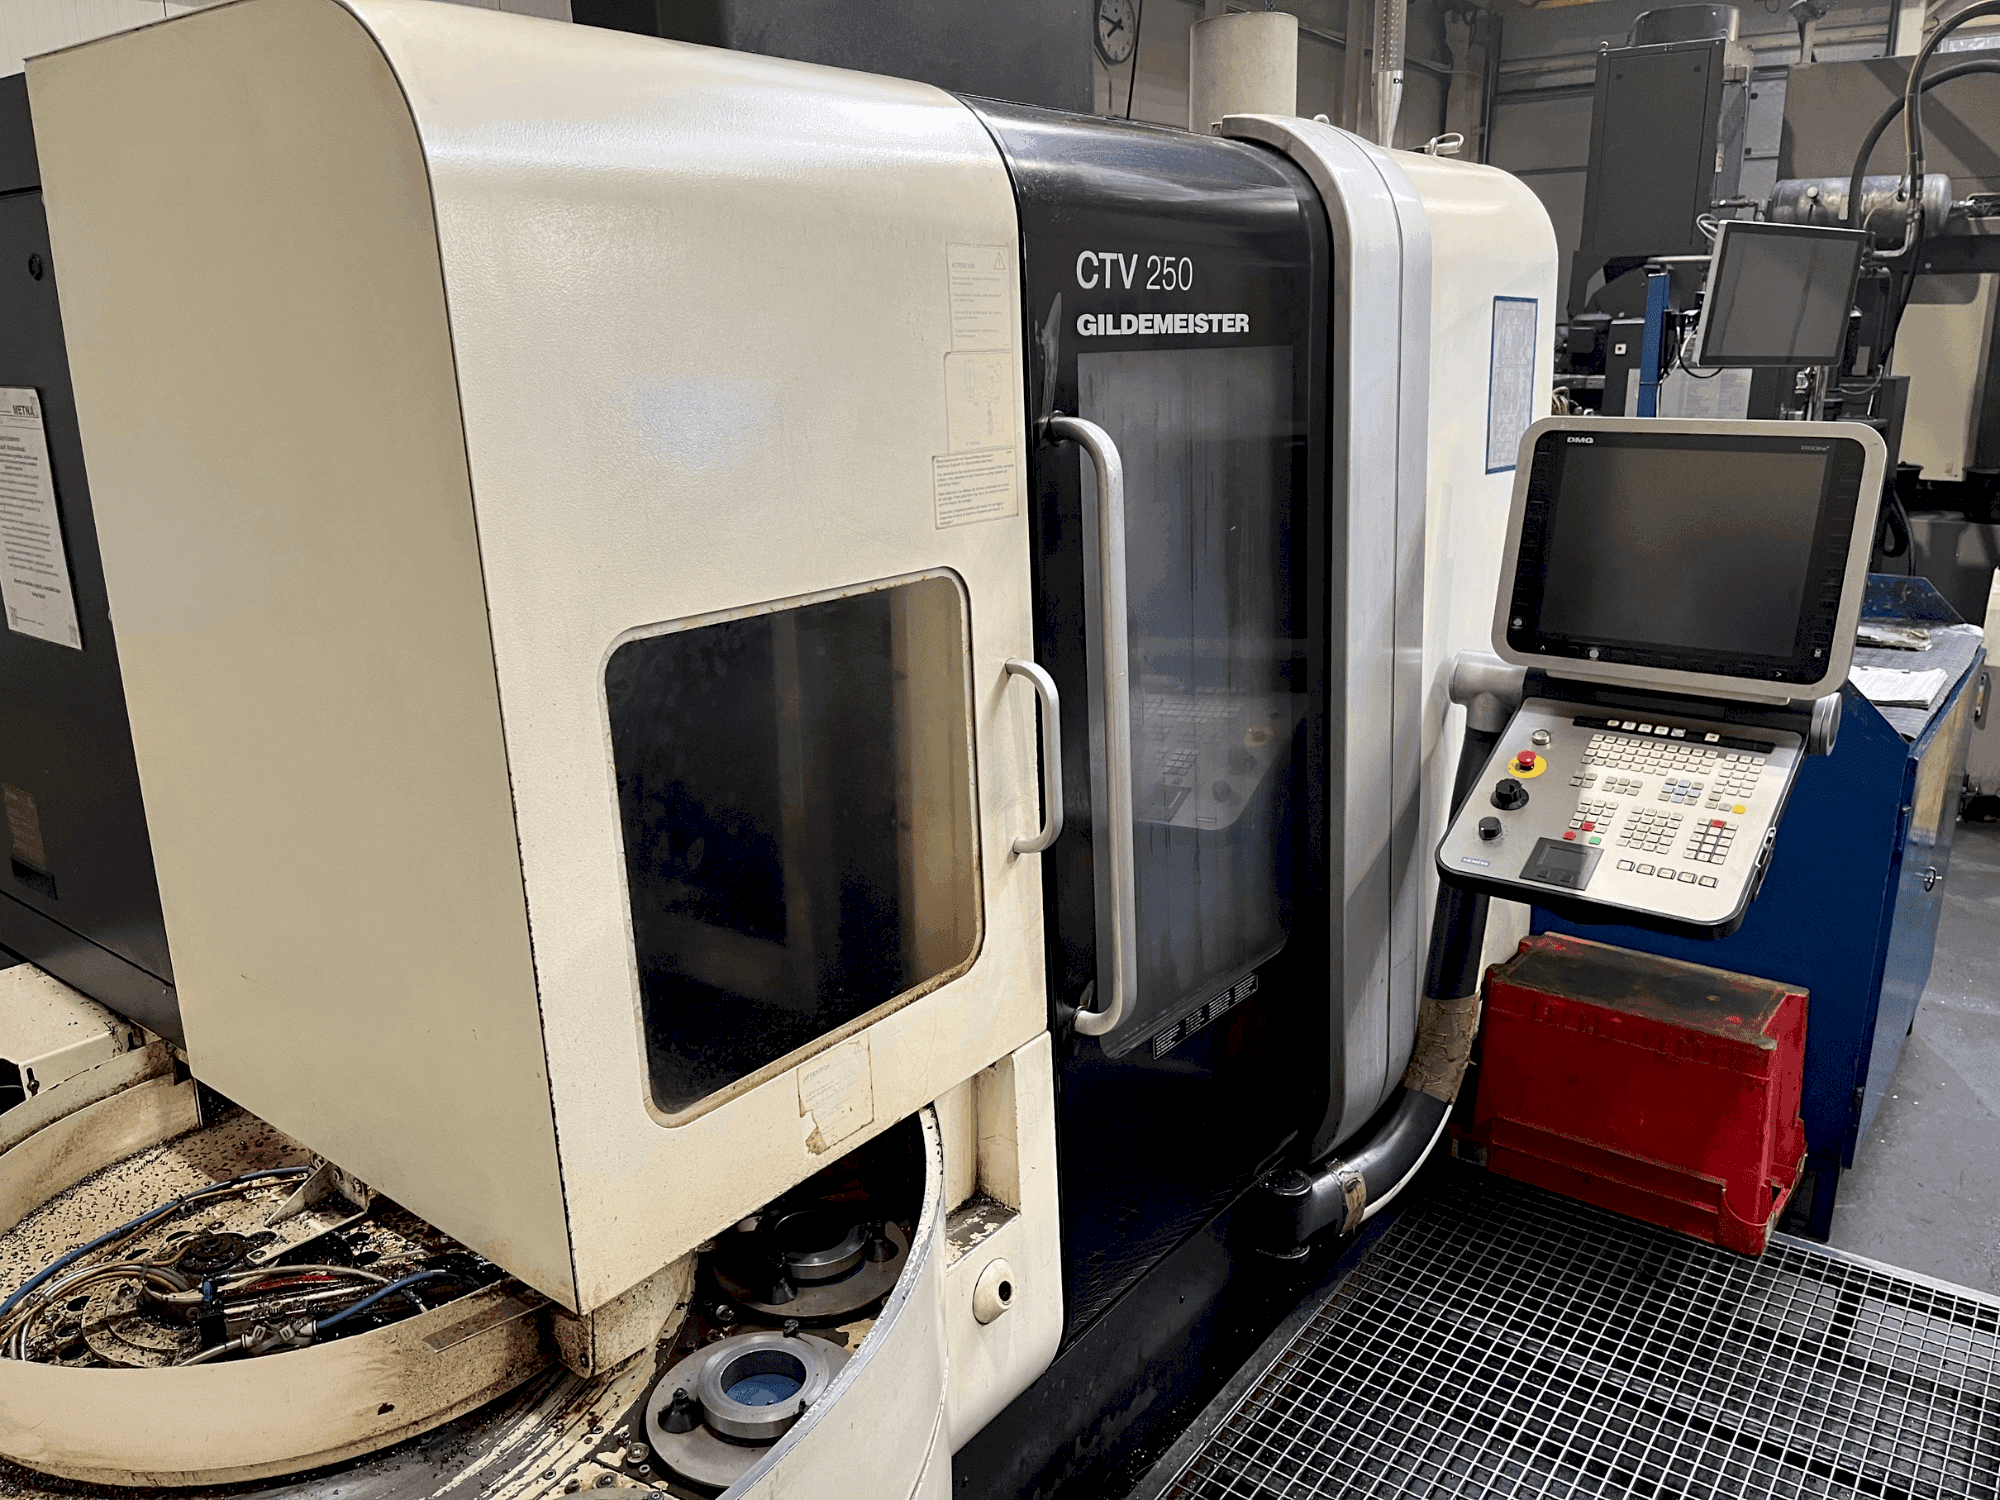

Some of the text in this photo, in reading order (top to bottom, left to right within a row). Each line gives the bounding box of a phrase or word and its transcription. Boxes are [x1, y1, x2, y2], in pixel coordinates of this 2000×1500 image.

[1076, 250, 1193, 291] CTV 250
[1077, 313, 1249, 336] GILDEMEISTER
[1566, 436, 1594, 444] DMG
